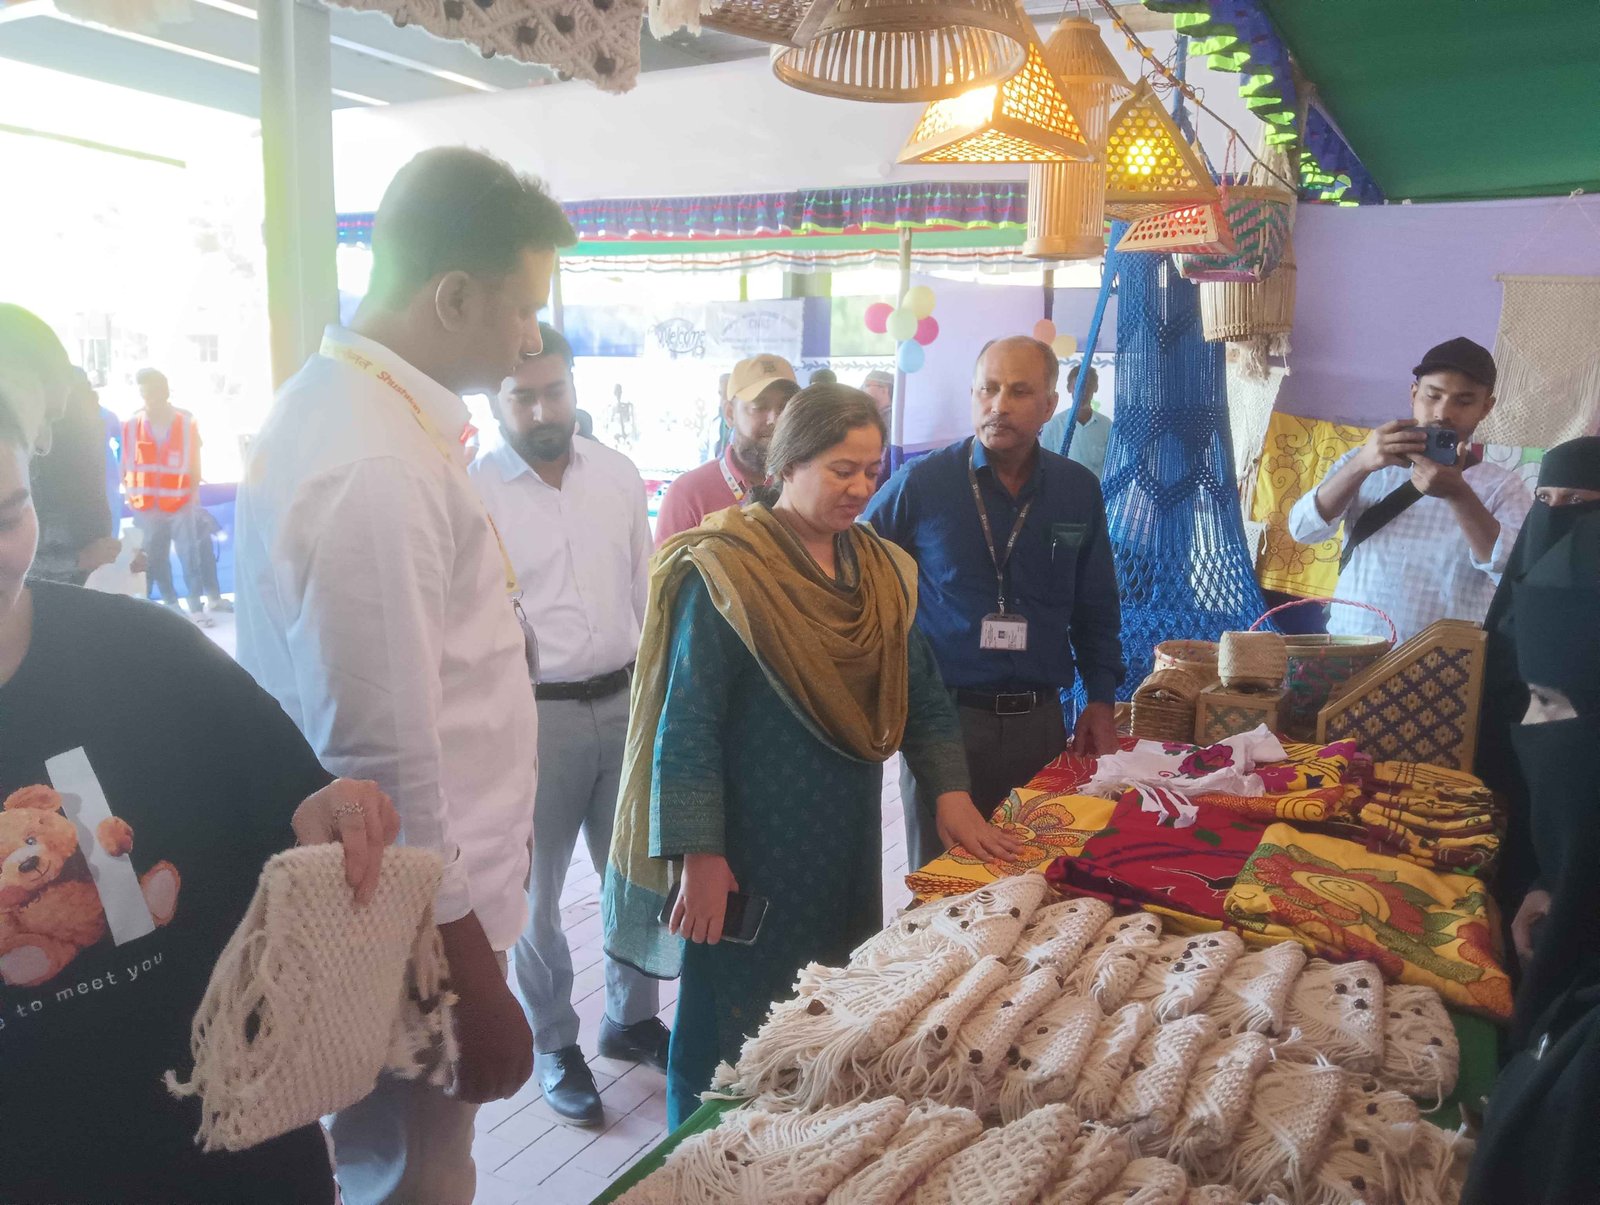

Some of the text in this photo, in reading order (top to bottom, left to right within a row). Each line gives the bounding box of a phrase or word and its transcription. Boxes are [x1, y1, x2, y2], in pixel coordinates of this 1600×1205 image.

[656, 326, 706, 348] Welcome
[16, 952, 163, 1018] to meet you
